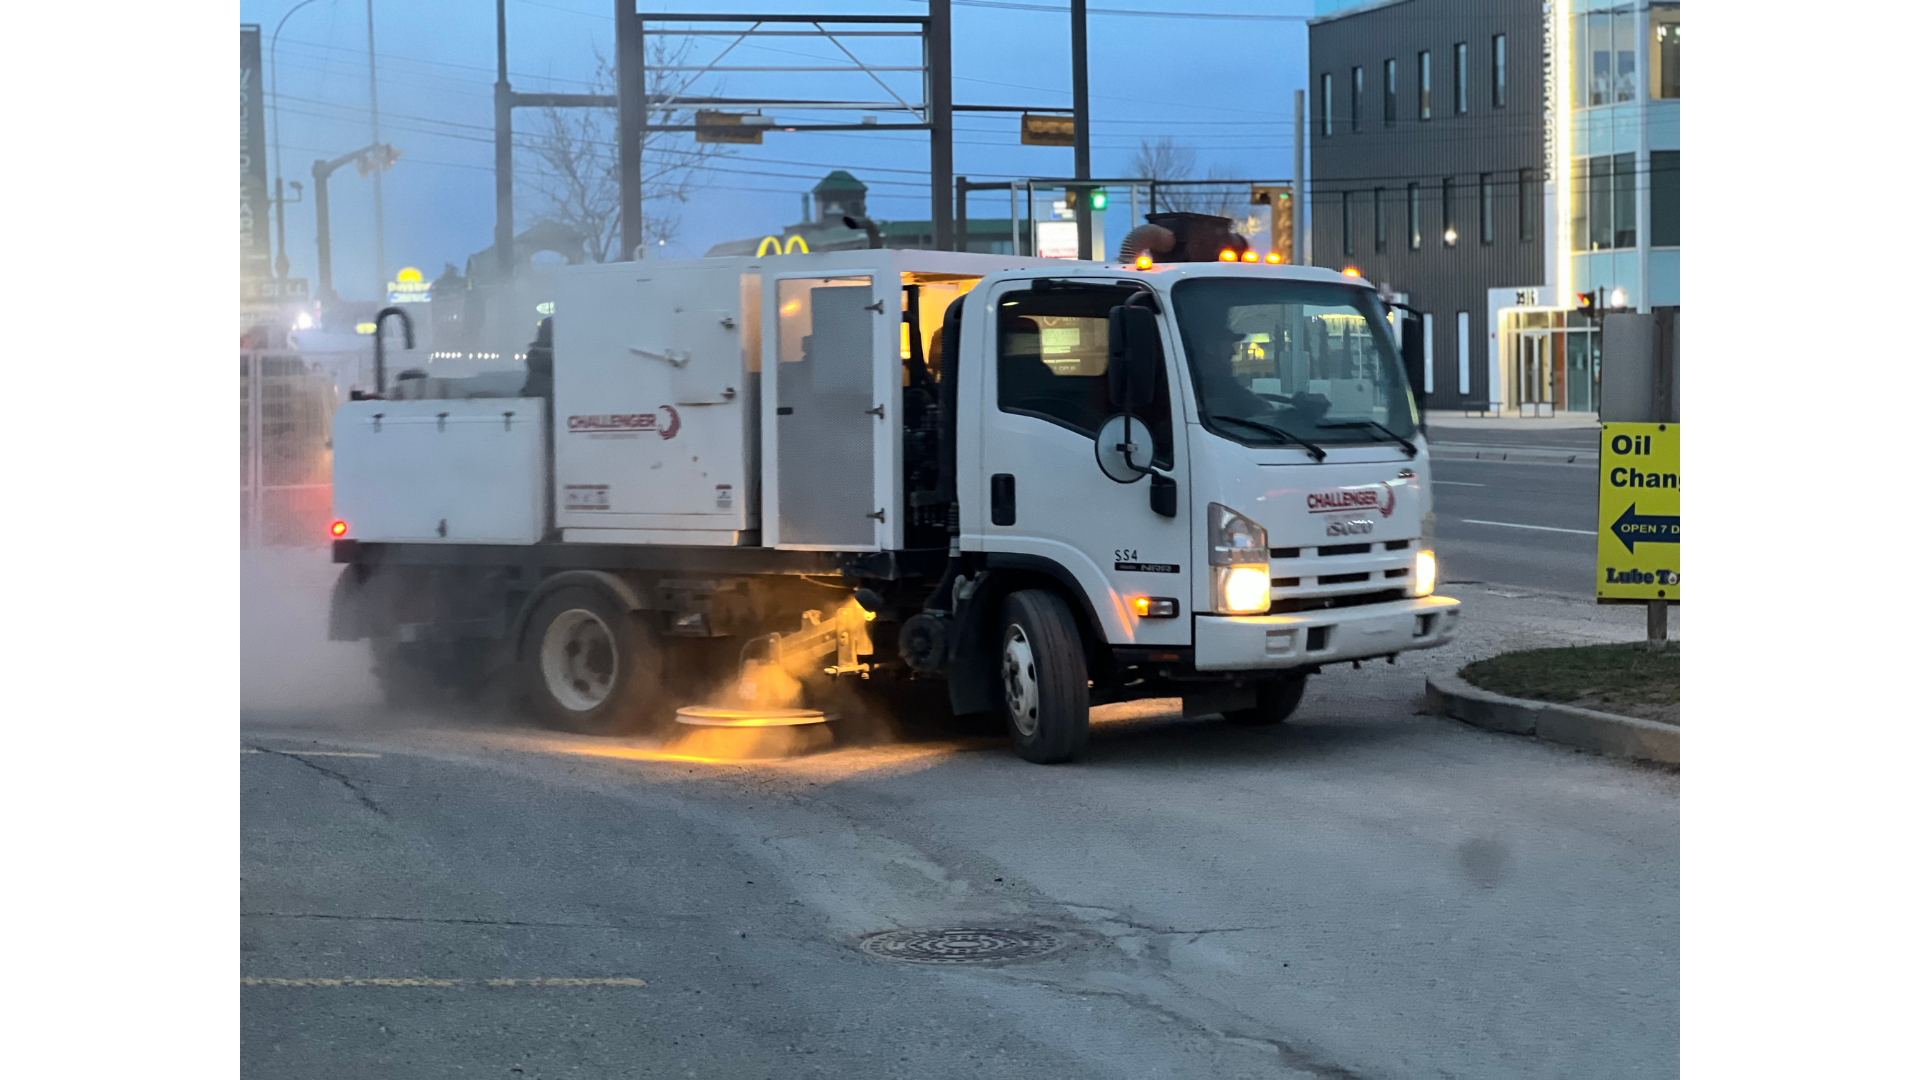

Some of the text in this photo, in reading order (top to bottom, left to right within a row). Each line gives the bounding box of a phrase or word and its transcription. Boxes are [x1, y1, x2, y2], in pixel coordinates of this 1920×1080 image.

[567, 413, 657, 429] CHALLENGER
[1611, 434, 1651, 456] Oil
[1610, 467, 1680, 492] Chan
[1307, 490, 1377, 509] CHALLENGER
[1621, 524, 1657, 534] OPEN
[1661, 524, 1668, 534] 7
[1115, 549, 1138, 562] SS4
[1606, 567, 1654, 584] Lube
